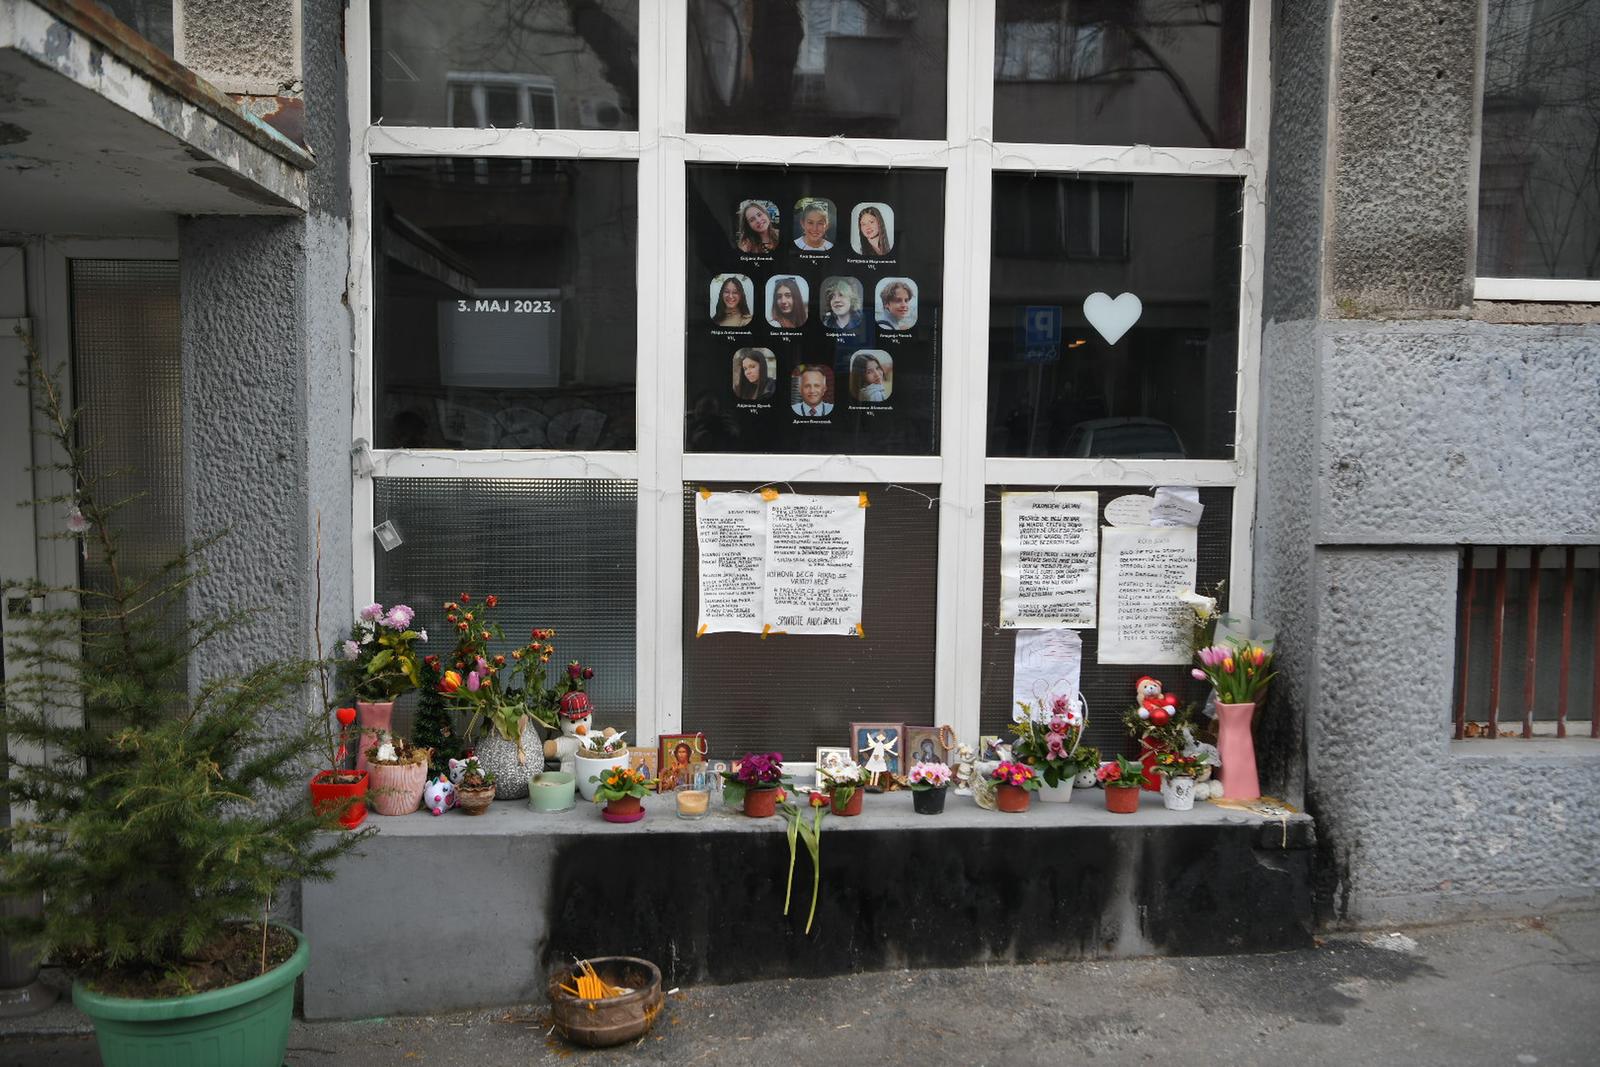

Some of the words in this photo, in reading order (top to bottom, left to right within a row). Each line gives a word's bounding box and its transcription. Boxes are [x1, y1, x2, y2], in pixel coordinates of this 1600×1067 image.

[457, 300, 471, 312] 3.
[474, 300, 510, 312] MAJ
[514, 300, 556, 313] 2023.
